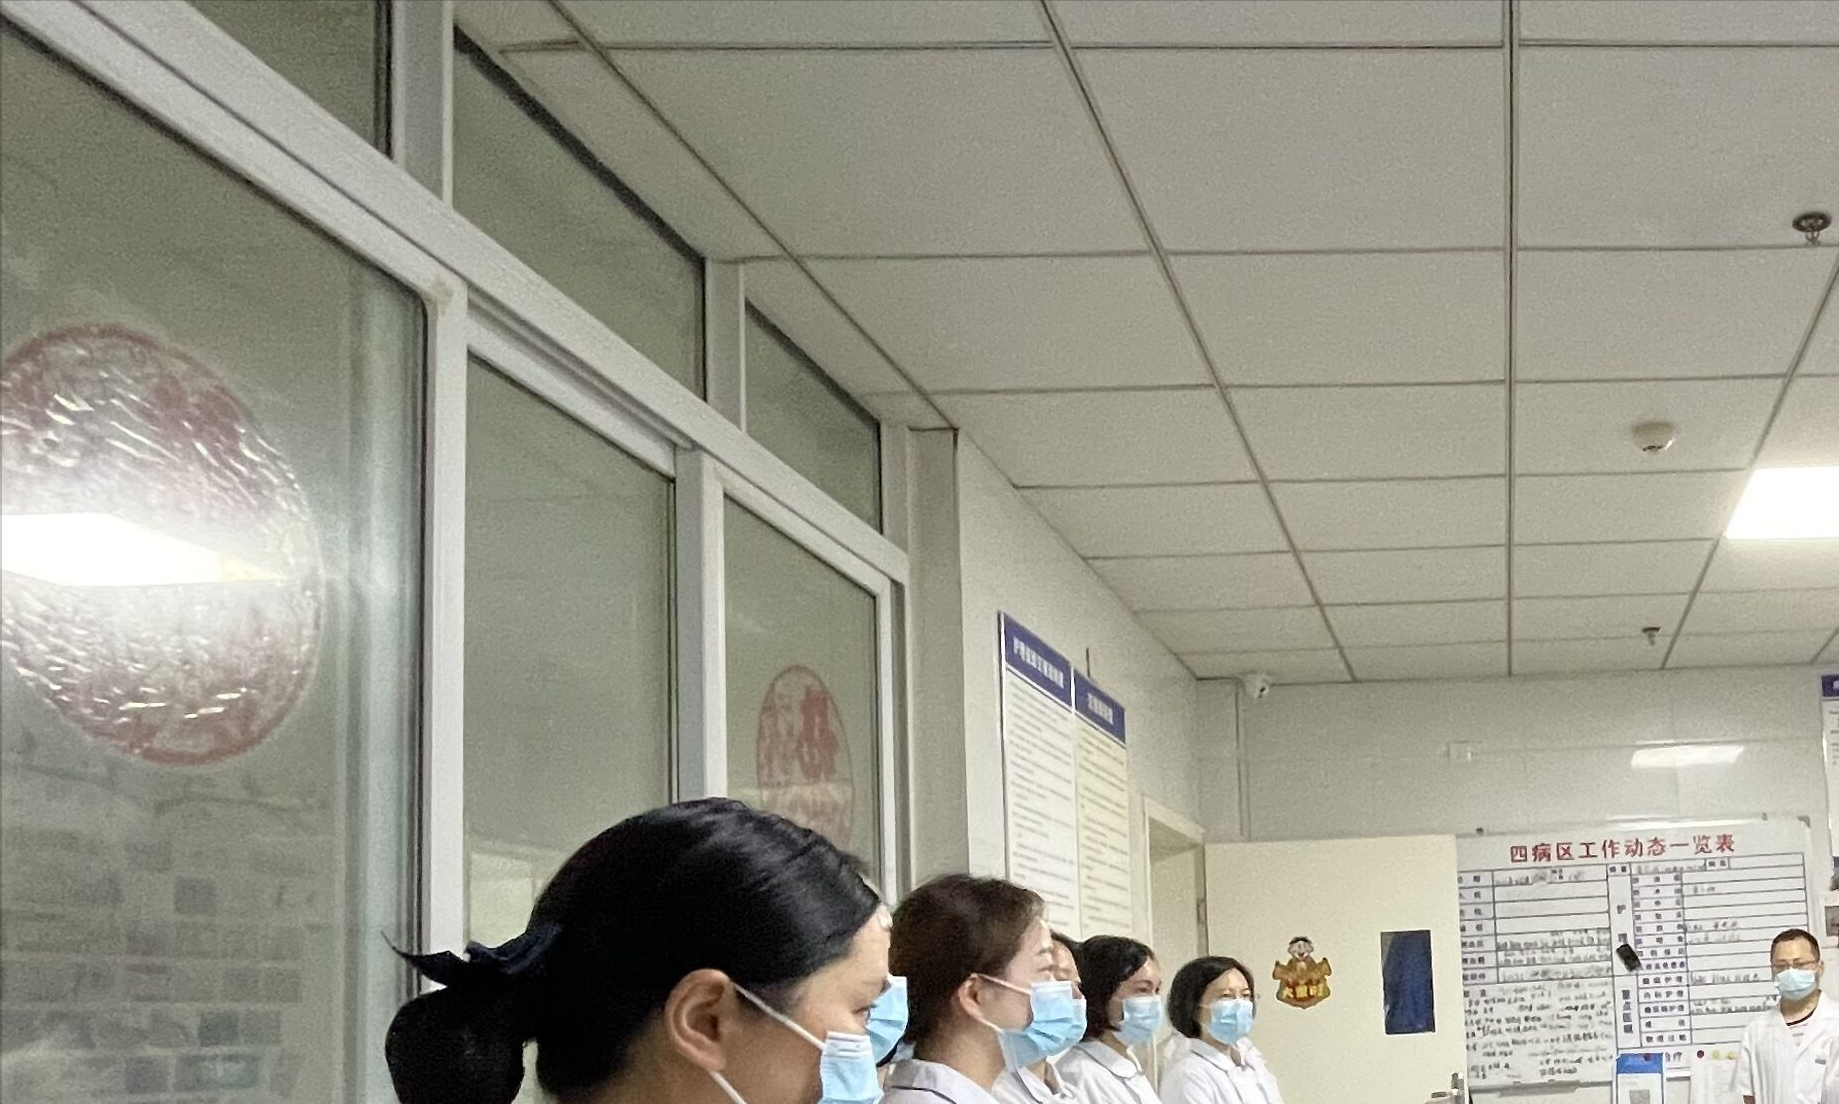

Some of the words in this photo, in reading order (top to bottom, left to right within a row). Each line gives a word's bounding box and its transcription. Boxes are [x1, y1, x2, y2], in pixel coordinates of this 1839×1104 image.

[1510, 833, 1735, 863] 四病区工作动态一览表
